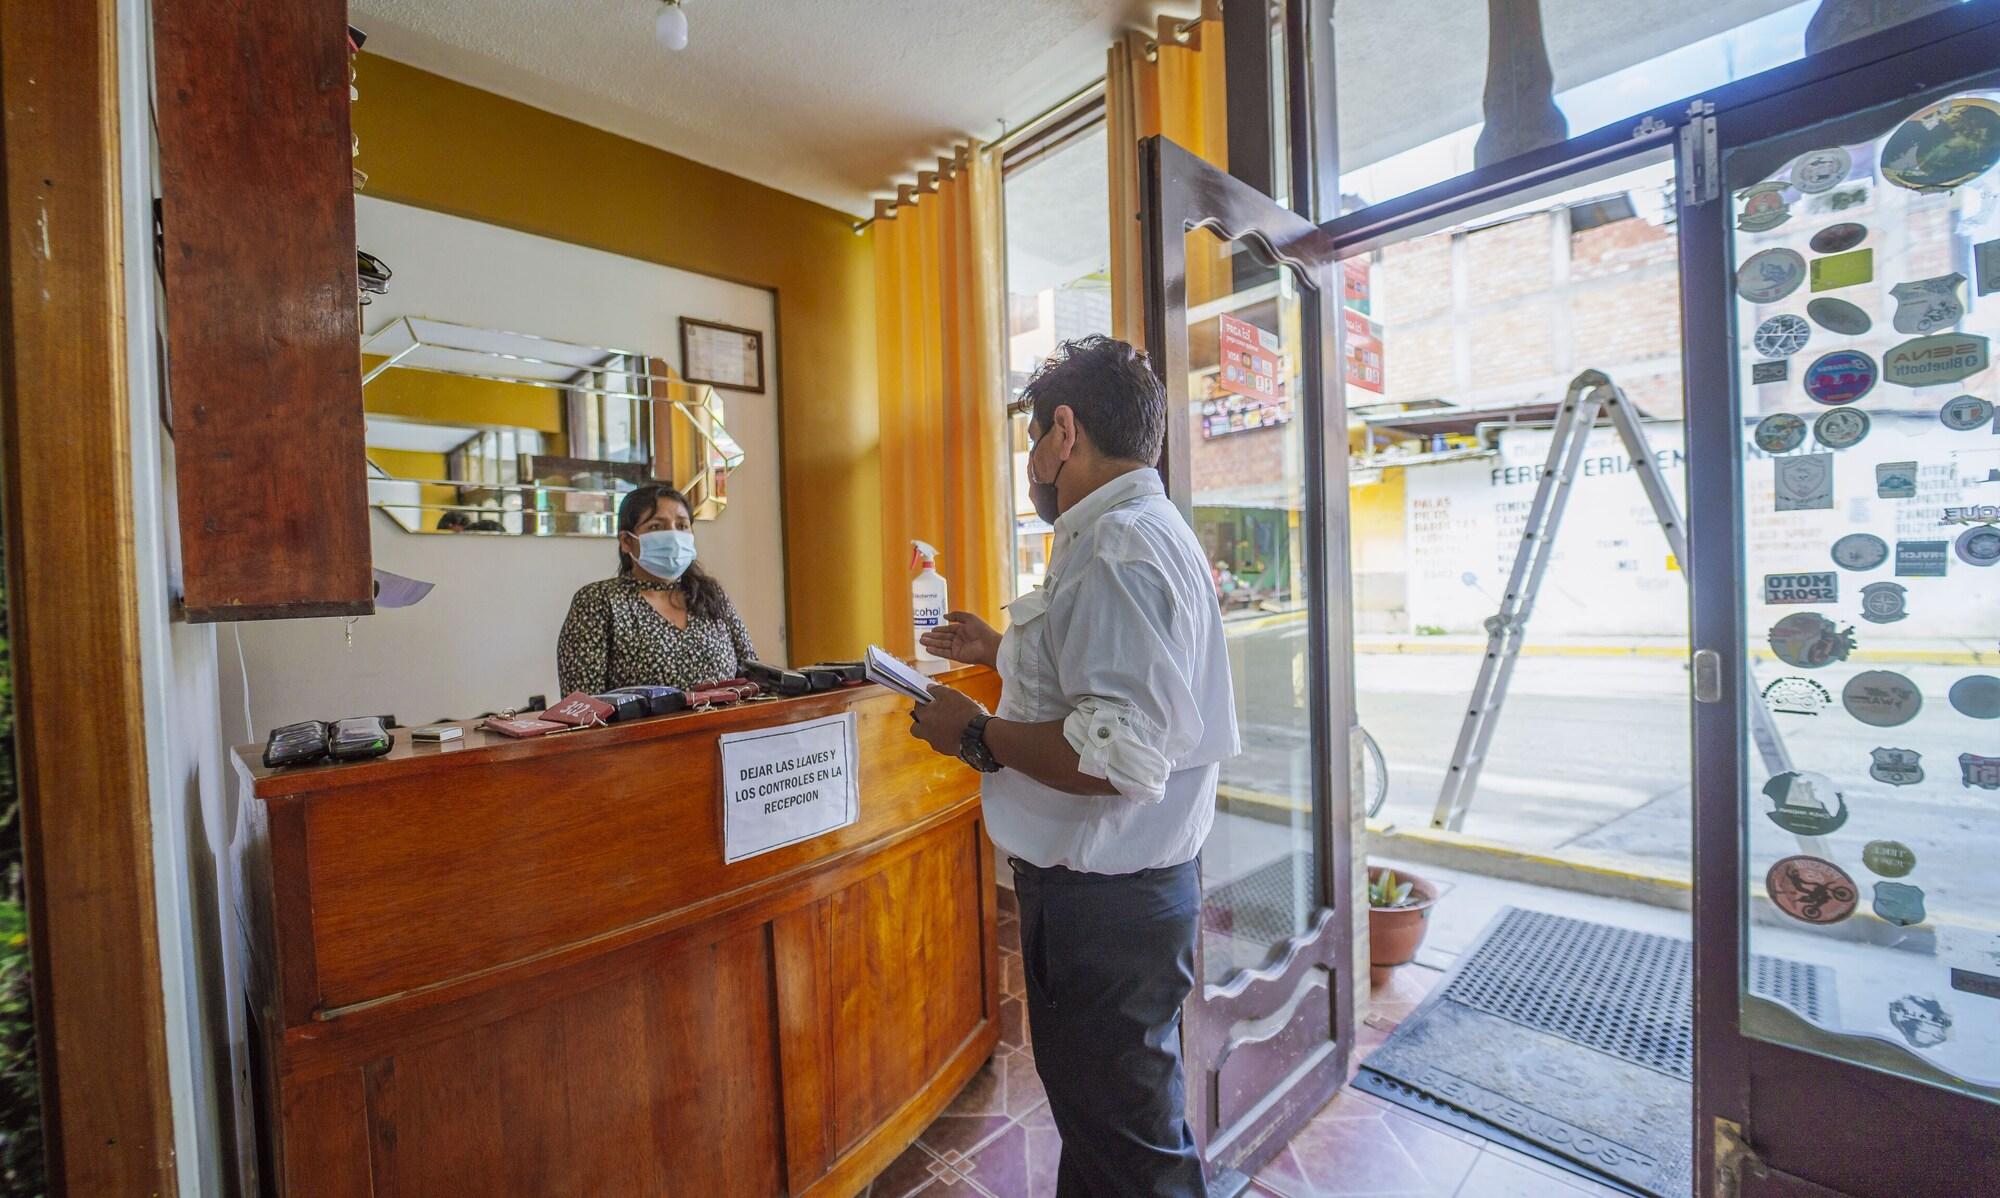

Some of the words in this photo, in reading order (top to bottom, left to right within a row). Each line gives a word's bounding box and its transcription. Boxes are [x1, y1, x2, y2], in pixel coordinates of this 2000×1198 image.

[560, 700, 591, 718] 302
[740, 763, 773, 781] DEJAR
[775, 759, 795, 776] LAS
[796, 751, 829, 769] LLAVES
[830, 749, 836, 761] Y
[735, 787, 756, 803] LOS
[758, 772, 814, 797] CONTROLES
[817, 769, 829, 781] EN
[831, 766, 842, 778] LA
[764, 789, 819, 815] RECEPCION
[1418, 1070, 1622, 1167] BIENVENIDOS
